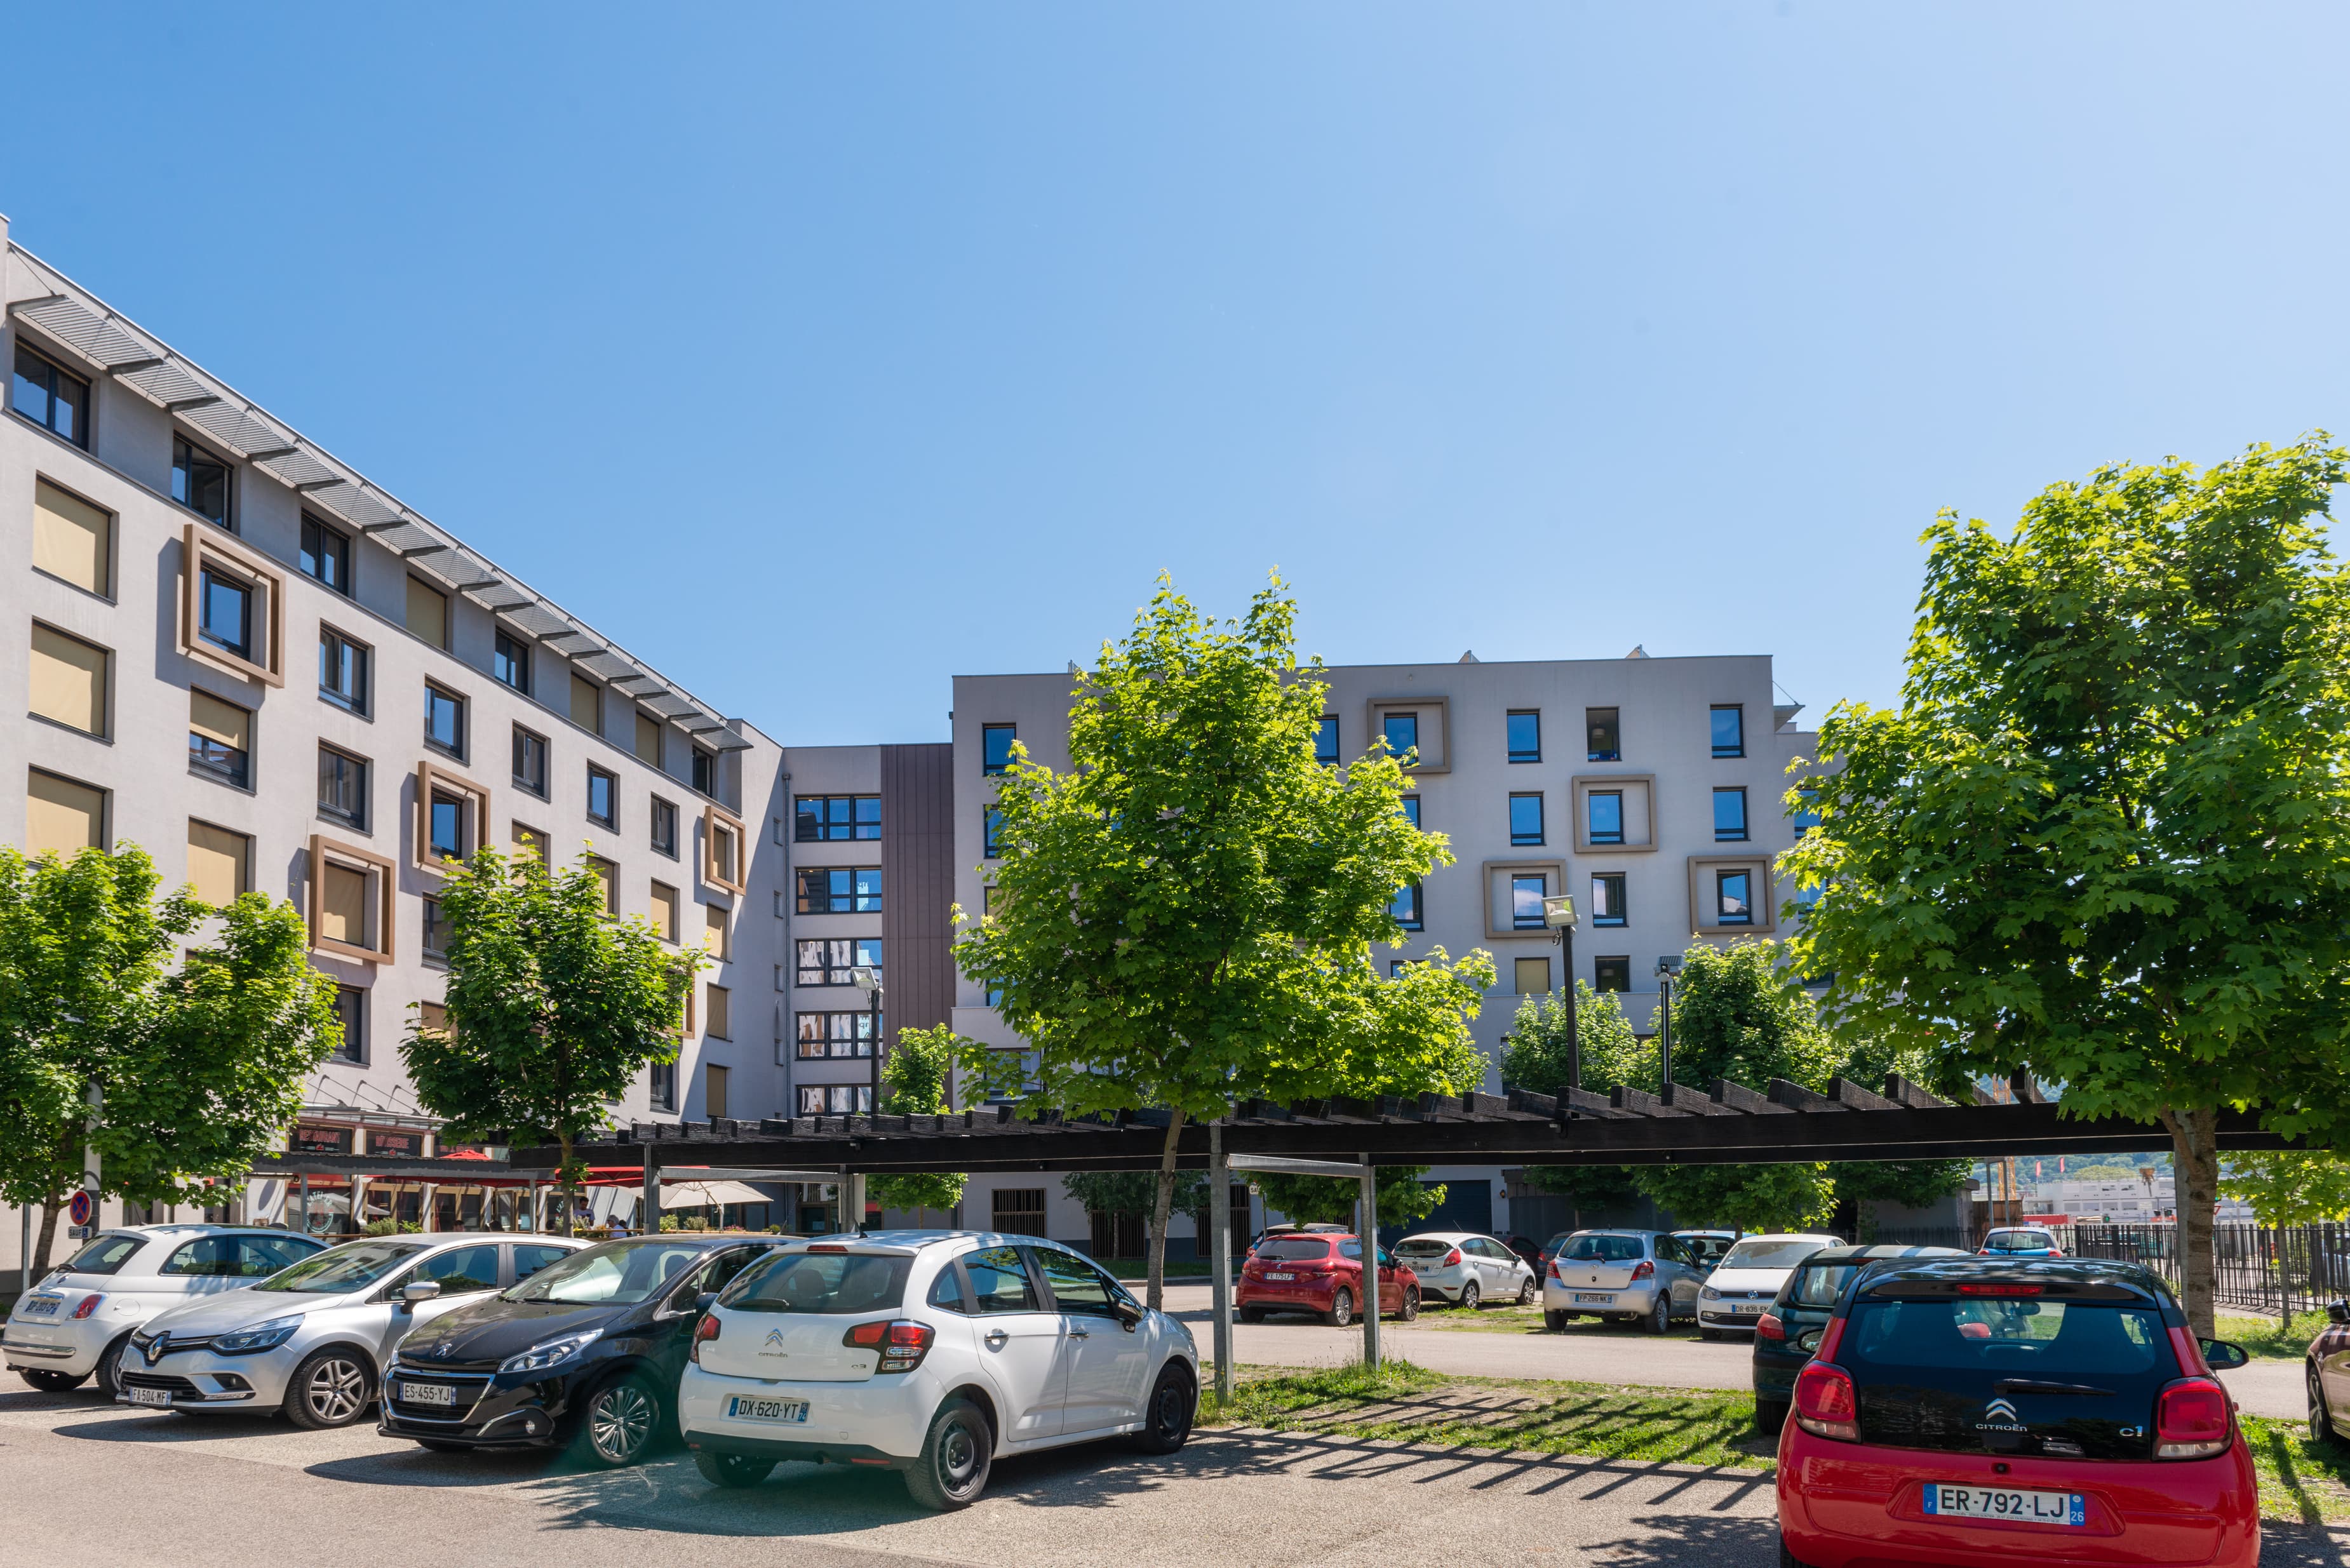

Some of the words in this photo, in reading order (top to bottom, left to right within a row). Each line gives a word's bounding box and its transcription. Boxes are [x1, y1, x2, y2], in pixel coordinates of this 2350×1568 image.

[133, 1389, 166, 1404] FA-504-MF
[405, 1384, 450, 1402] ES-455-YJ
[739, 1400, 799, 1419] DX-620-YT
[2119, 1425, 2144, 1437] C1
[1941, 1488, 2064, 1518] ER-792-LJ
[2071, 1511, 2084, 1522] 26
